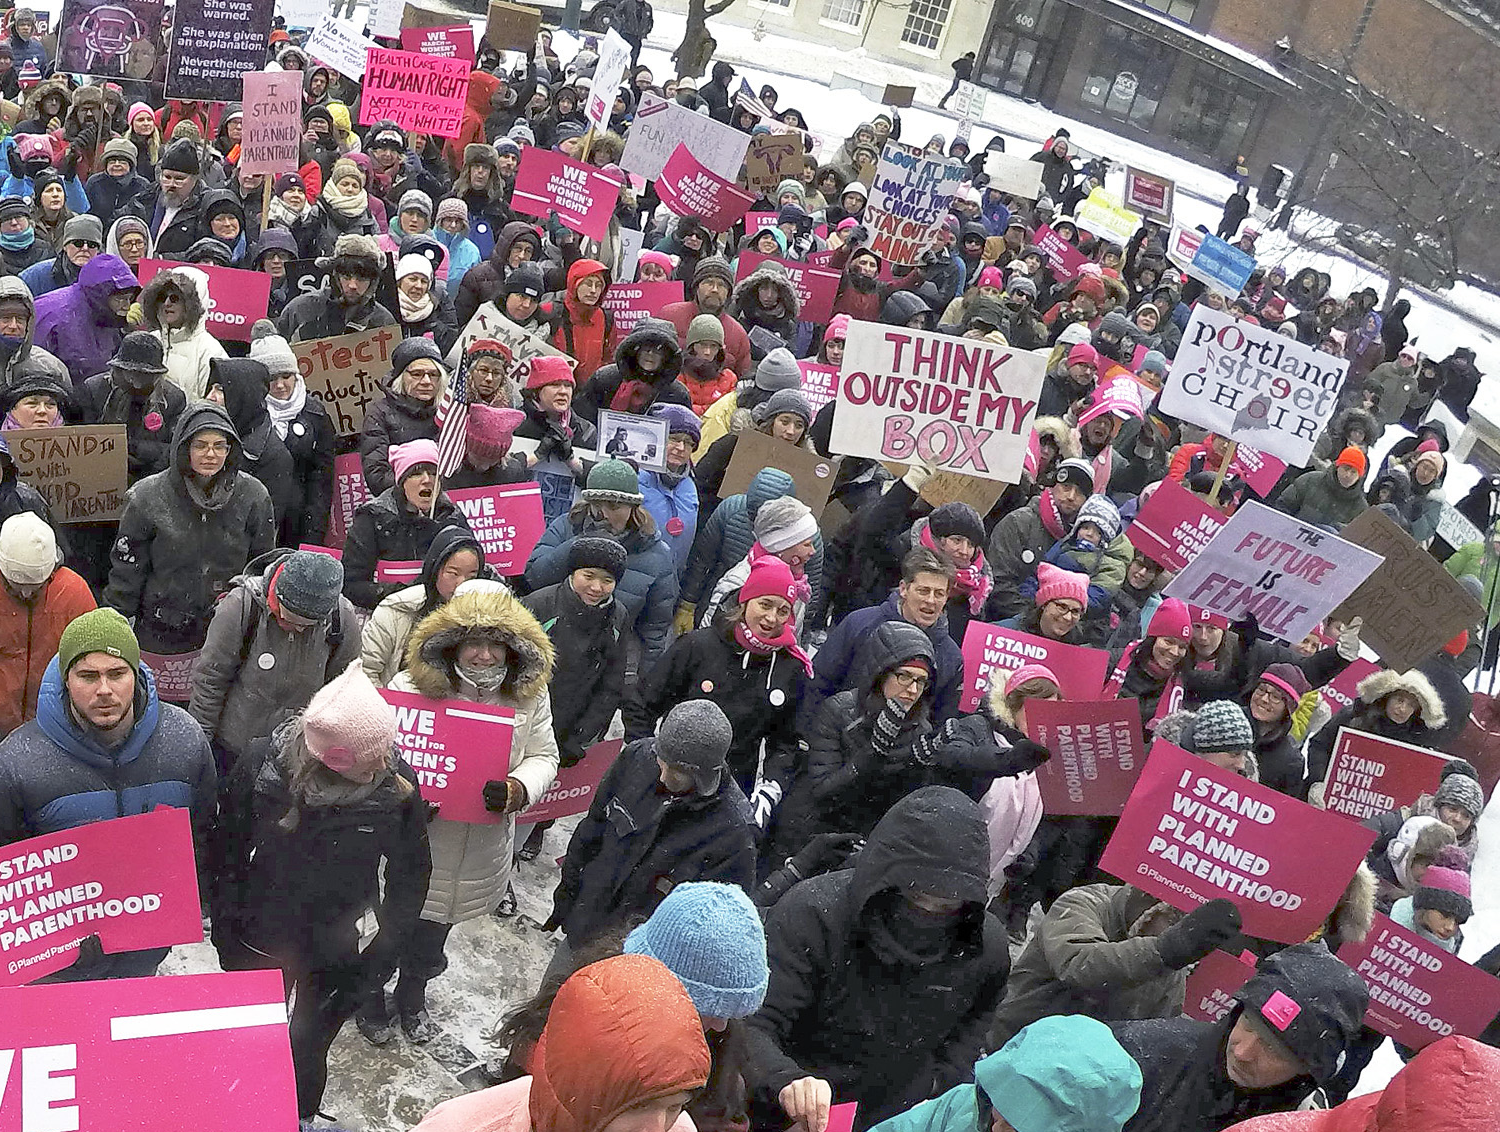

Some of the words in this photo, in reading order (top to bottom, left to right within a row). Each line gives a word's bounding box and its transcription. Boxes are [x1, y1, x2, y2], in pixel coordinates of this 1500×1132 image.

[203, 10, 250, 20] warned.
[204, 0, 226, 9] She
[1014, 12, 1035, 28] 400
[178, 38, 192, 47] an
[196, 39, 265, 51] explanation.
[182, 27, 206, 37] She
[208, 31, 231, 39] was
[233, 30, 264, 42] given
[178, 66, 199, 78] she
[180, 56, 257, 70] Nevertheless,
[442, 63, 453, 73] IS
[457, 65, 466, 76] A
[267, 84, 277, 97] I
[367, 67, 425, 93] HUMAN
[252, 100, 297, 117] STAND
[366, 108, 406, 125] RICH
[396, 97, 419, 110] JUST
[250, 126, 296, 142] PLANNED
[563, 164, 588, 185] WE
[883, 147, 922, 173] LOOK
[921, 161, 941, 179] AT
[546, 183, 593, 207] WOMEN'S
[551, 175, 583, 192] MARCH
[683, 175, 712, 199] MARCH
[695, 172, 721, 195] WE
[873, 174, 906, 200] LOOK
[905, 189, 926, 206] AT
[905, 170, 942, 195] LIFE
[555, 196, 588, 215] RIGHTS
[677, 179, 721, 213] WOMEN'S
[680, 194, 714, 218] RIGHTS
[864, 205, 903, 236] STAY
[901, 222, 930, 241] OUT
[883, 197, 940, 225] CHOICES
[870, 231, 925, 265] MINE
[885, 332, 1013, 394] THINK
[843, 372, 971, 423] OUTSIDE
[976, 393, 1036, 435] MY
[1181, 372, 1319, 442] CHOIR
[19, 434, 98, 463] STAND
[881, 414, 993, 473] BOX
[457, 498, 496, 518] WE
[1295, 527, 1325, 547] THE
[1233, 531, 1338, 586] FUTURE
[1255, 570, 1282, 591] IS
[1189, 572, 1309, 636] FEMALE
[984, 649, 1025, 668] WITH
[985, 633, 992, 646] I
[995, 637, 1048, 661] STAND
[1076, 725, 1098, 780] PLANNED
[1095, 722, 1114, 759] WITH
[1114, 729, 1135, 771] STAND
[1344, 740, 1350, 753] I
[1056, 725, 1084, 802] PARENTHOOD
[1340, 754, 1386, 777] STAND
[1337, 768, 1373, 789] WITH
[1178, 769, 1192, 788] I
[1192, 778, 1276, 825] STAND
[1331, 782, 1395, 810] PLANNED
[1172, 792, 1239, 837] WITH
[1158, 814, 1270, 877] PLANNED
[0, 843, 79, 881] STAND
[1148, 836, 1302, 911] PARENTHOOD
[0, 894, 161, 951] PARENTHOOD
[1370, 945, 1415, 978] WITH
[1378, 929, 1389, 942] I
[1387, 936, 1443, 972] STAND
[1358, 959, 1432, 1006] PLANNED
